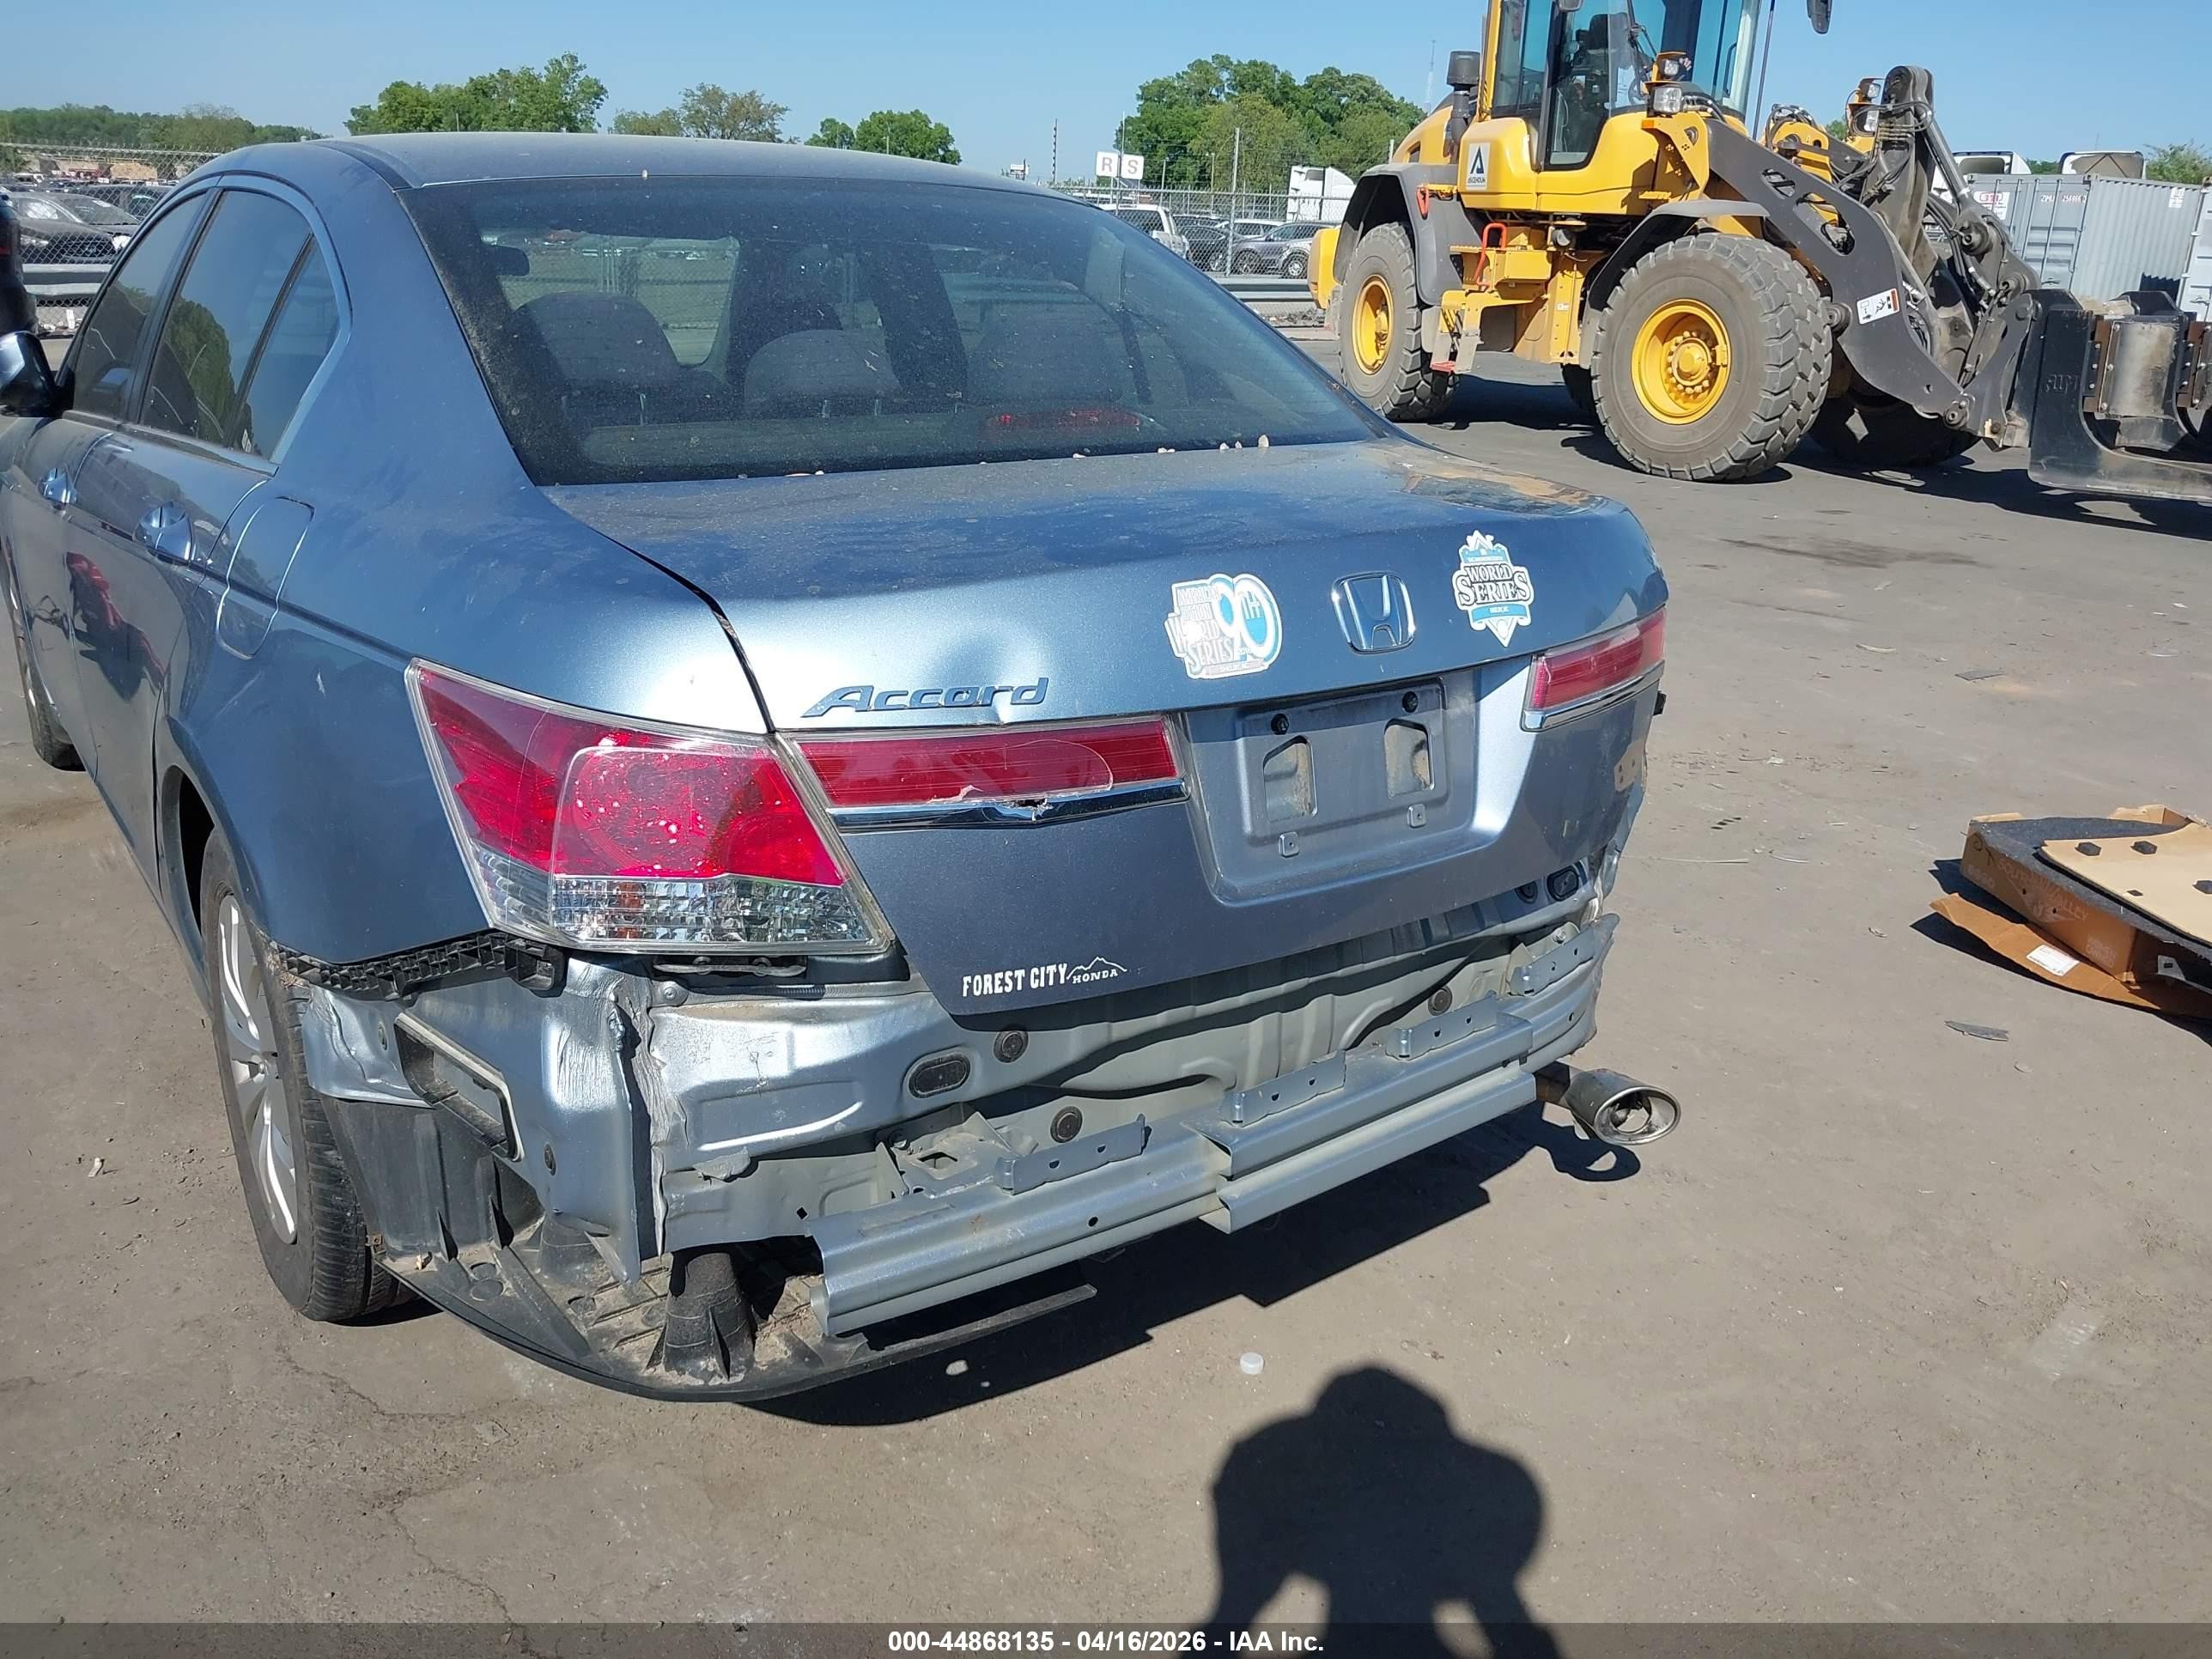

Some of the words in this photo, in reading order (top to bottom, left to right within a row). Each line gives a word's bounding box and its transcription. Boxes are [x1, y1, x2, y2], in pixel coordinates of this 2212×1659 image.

[1101, 156, 1113, 173] R
[1127, 159, 1139, 174] S
[1463, 563, 1514, 584] WORLD
[1456, 571, 1530, 606] SERIES
[1187, 637, 1235, 676] SERIES
[800, 678, 1049, 718] Accord
[962, 969, 1026, 998] FOREST
[1030, 963, 1068, 989] CITY
[1072, 969, 1119, 984] HONDA
